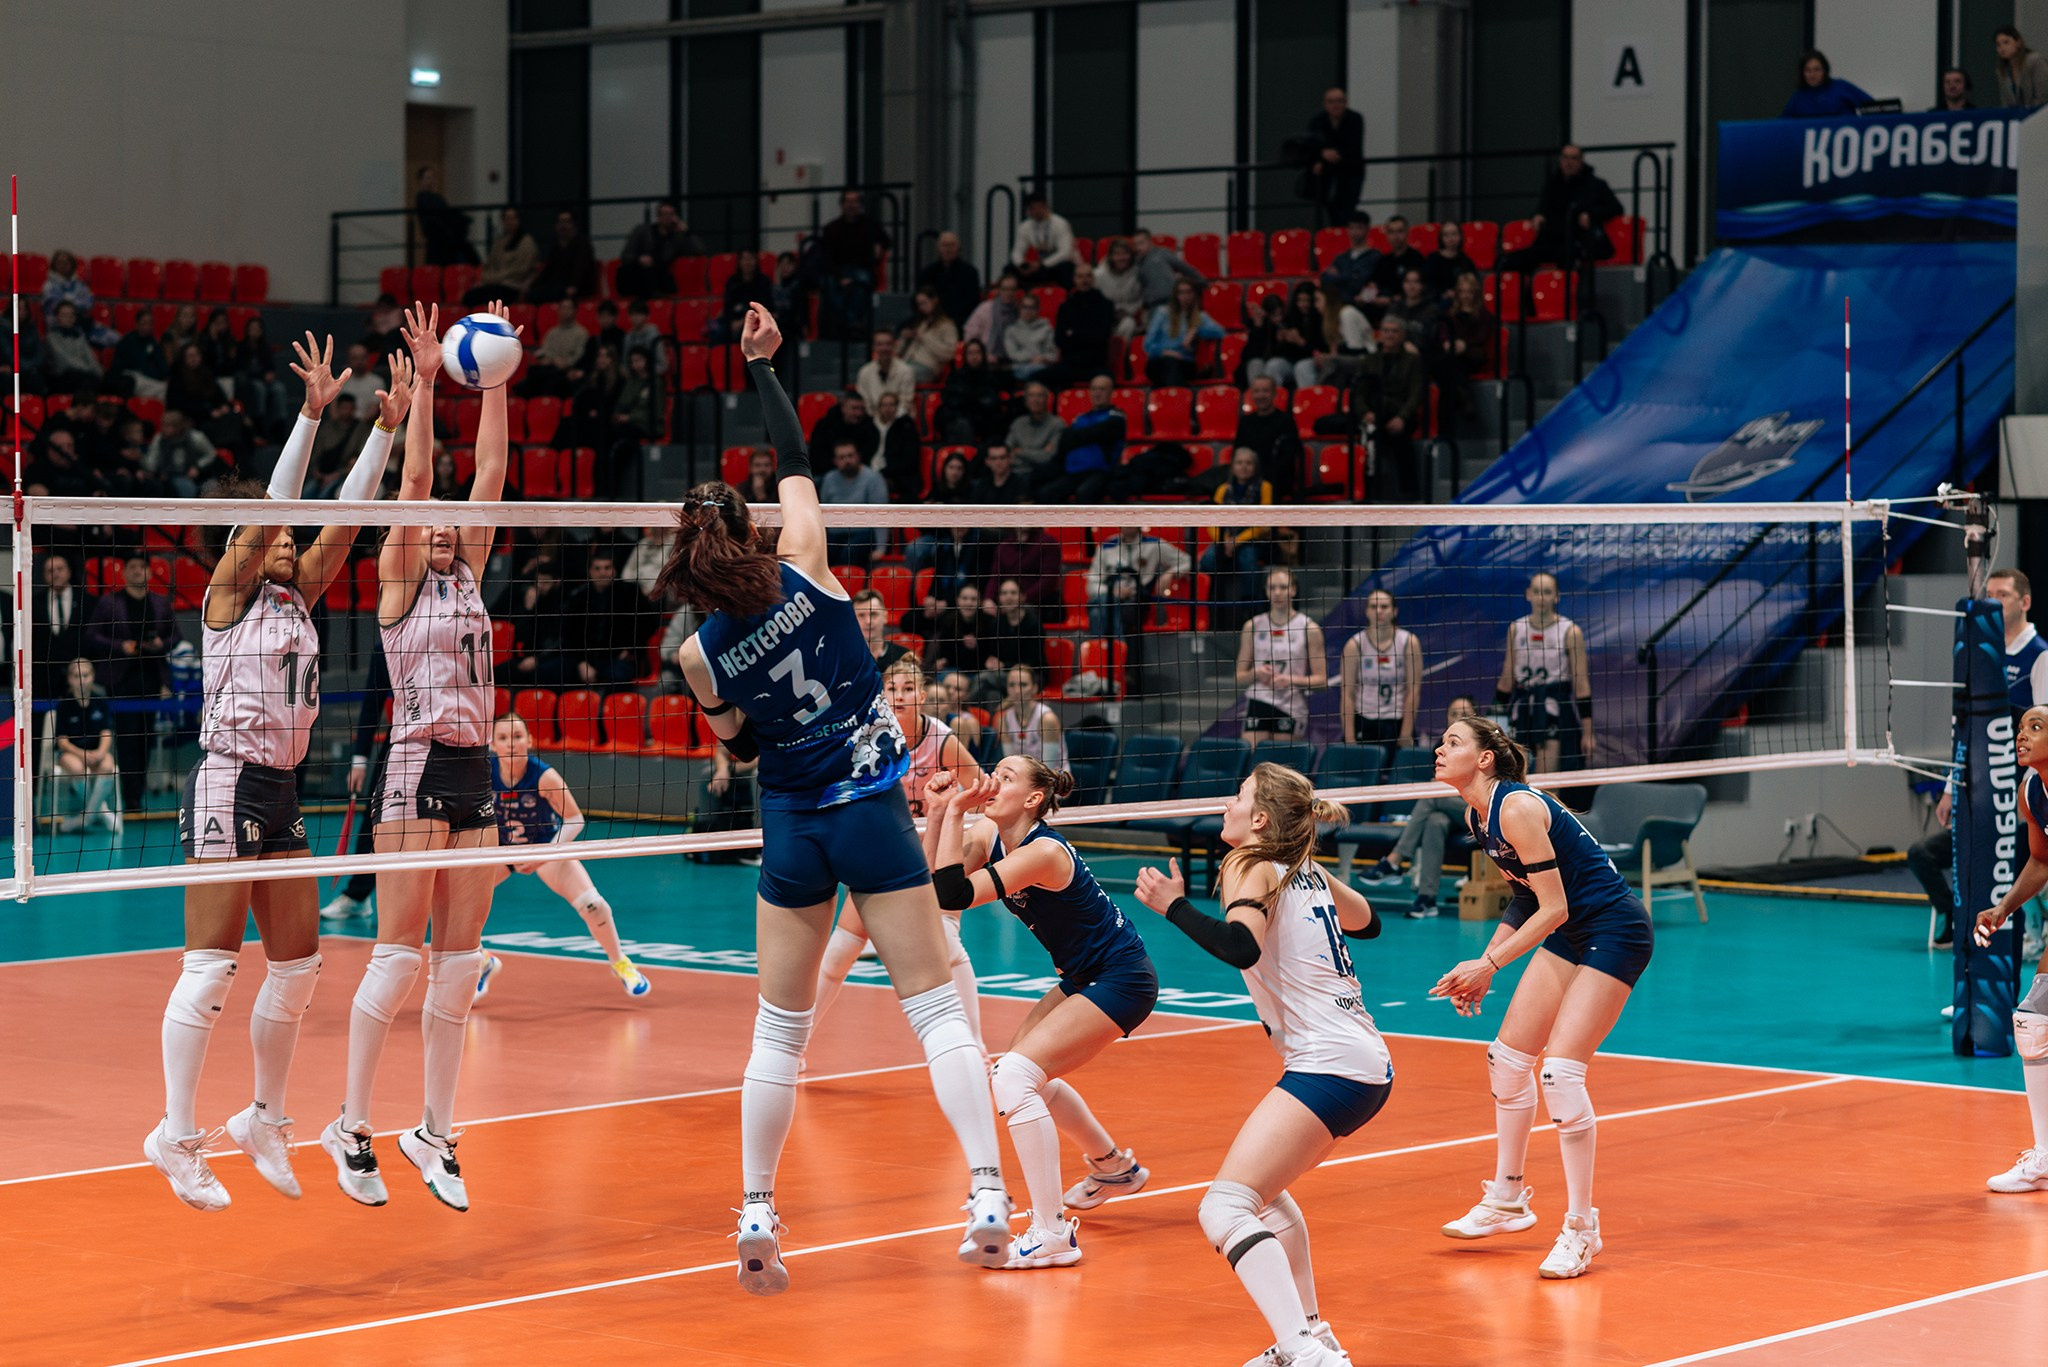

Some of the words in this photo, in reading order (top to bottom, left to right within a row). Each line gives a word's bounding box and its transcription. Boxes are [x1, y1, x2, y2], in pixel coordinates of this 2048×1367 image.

[717, 591, 816, 679] НЕСТЕРОВА
[278, 651, 320, 710] 16
[768, 648, 832, 726] 3
[242, 819, 261, 842] 16
